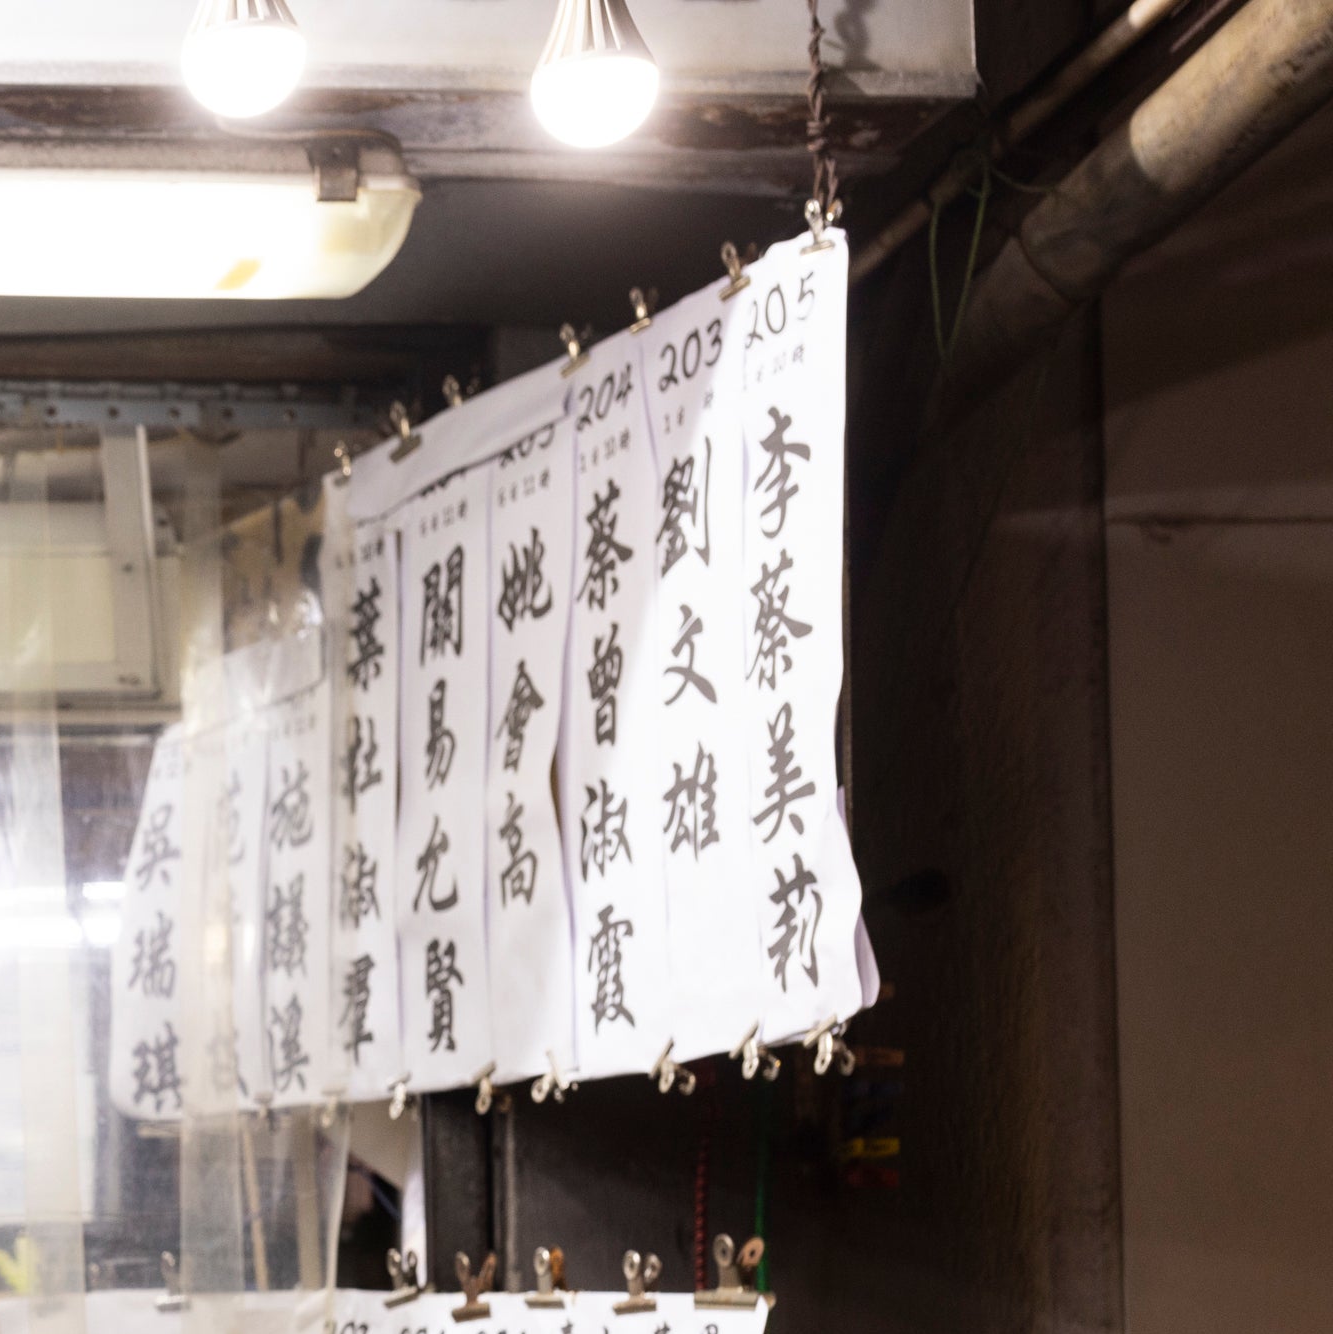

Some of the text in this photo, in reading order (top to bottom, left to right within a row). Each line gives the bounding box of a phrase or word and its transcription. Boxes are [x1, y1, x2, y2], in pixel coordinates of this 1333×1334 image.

[576, 362, 633, 431] 204
[659, 318, 722, 392] 203
[744, 271, 815, 349] 205
[577, 478, 635, 1035] 蔡曾淑霞
[656, 436, 720, 862] 劉文雄
[744, 406, 822, 993] 李蔡美莉
